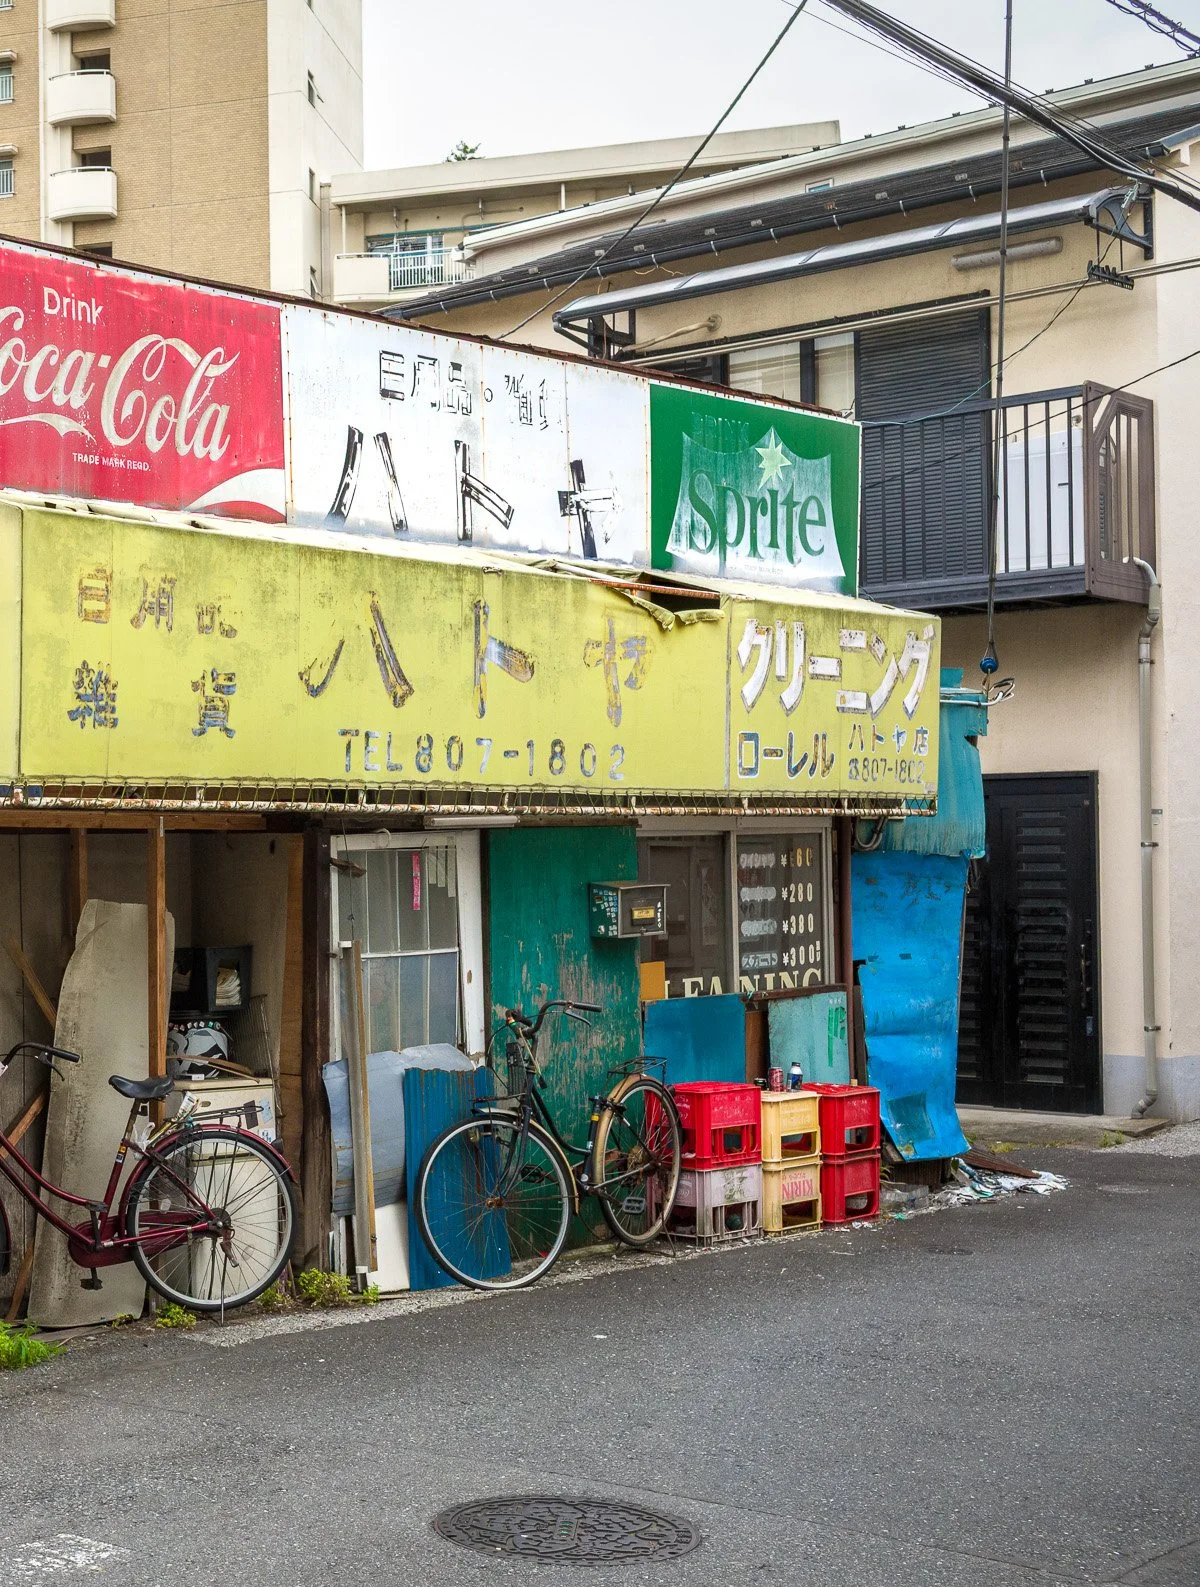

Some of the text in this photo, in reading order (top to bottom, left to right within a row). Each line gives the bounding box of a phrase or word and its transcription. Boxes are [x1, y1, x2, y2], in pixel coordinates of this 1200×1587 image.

[43, 287, 104, 325] Drink
[72, 452, 100, 465] TRADE
[101, 457, 126, 469] MARK
[688, 469, 827, 565] Sprite
[737, 618, 936, 721] クリーニング
[848, 723, 929, 756] ハトヤ店
[738, 730, 835, 779] ローレル
[781, 882, 813, 903] ¥280
[782, 913, 814, 935] ¥380
[783, 944, 815, 967] ¥300
[781, 1178, 814, 1201] KIRIN
